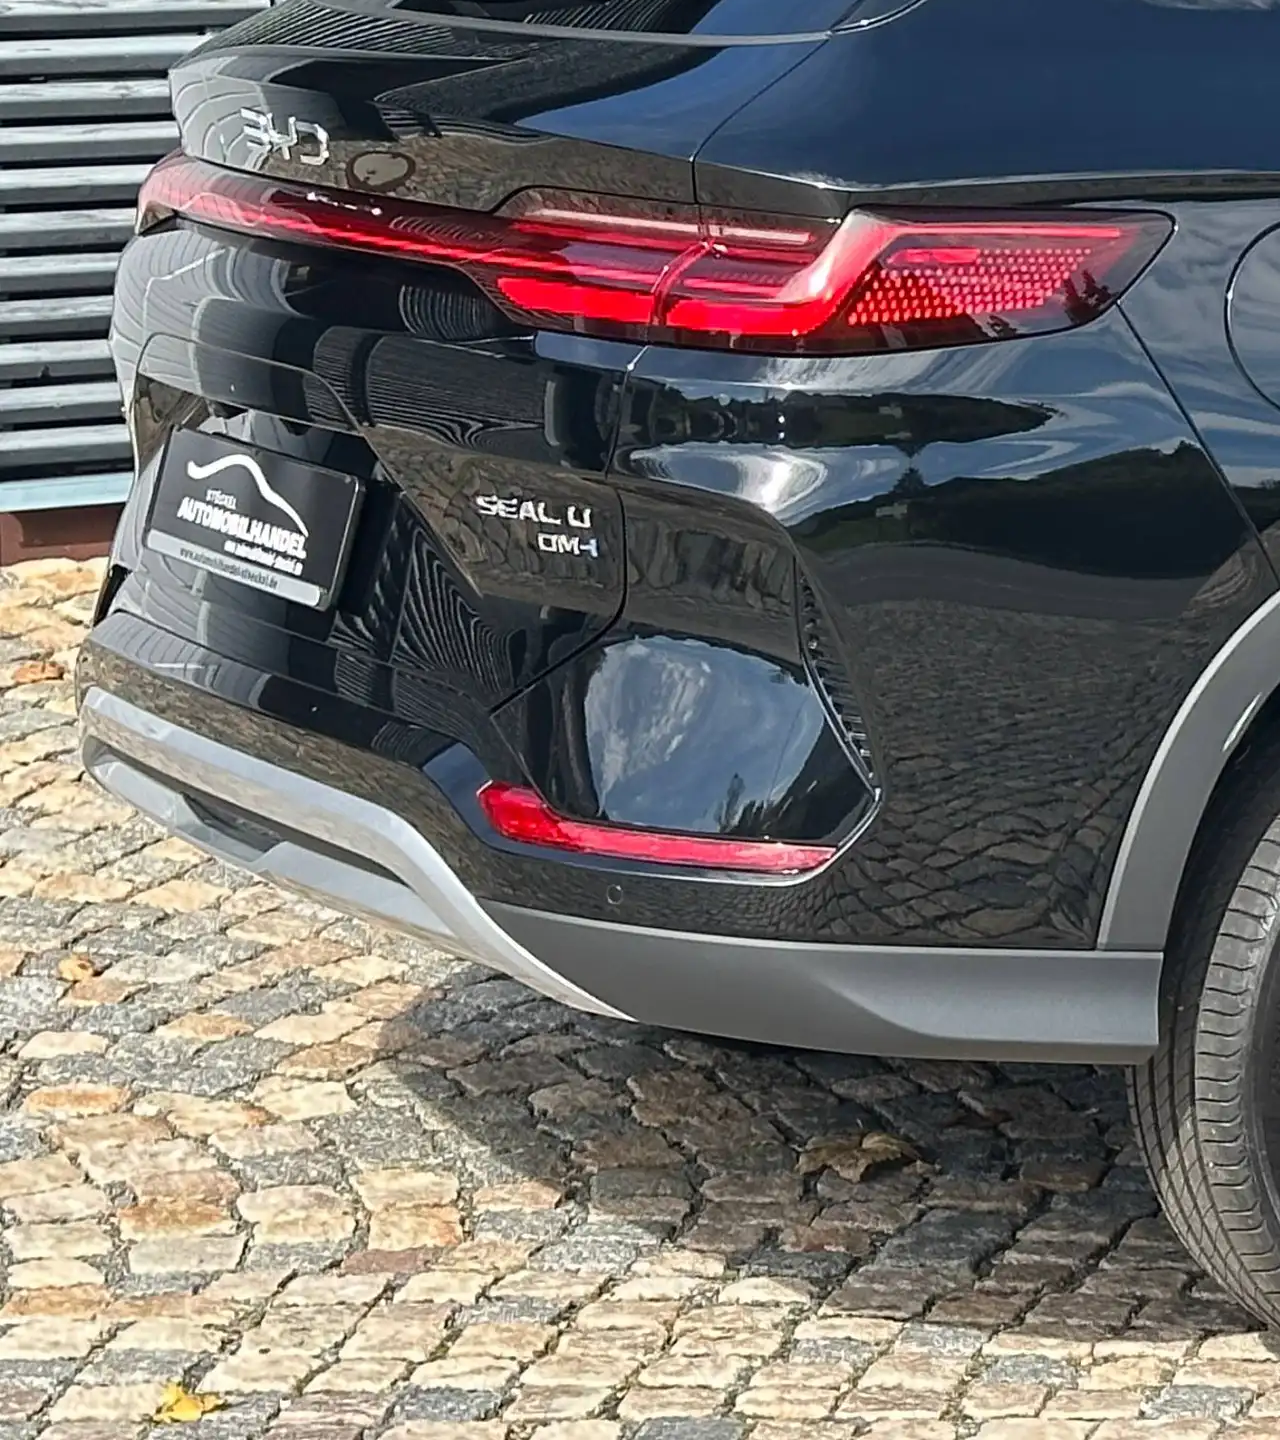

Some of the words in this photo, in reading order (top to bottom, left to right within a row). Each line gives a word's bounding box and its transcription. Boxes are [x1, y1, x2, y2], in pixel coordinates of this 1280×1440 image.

[240, 106, 330, 166] BYD
[176, 495, 307, 559] AUTOMOBILHANDEL
[475, 494, 562, 526] SEAL
[567, 505, 592, 529] U
